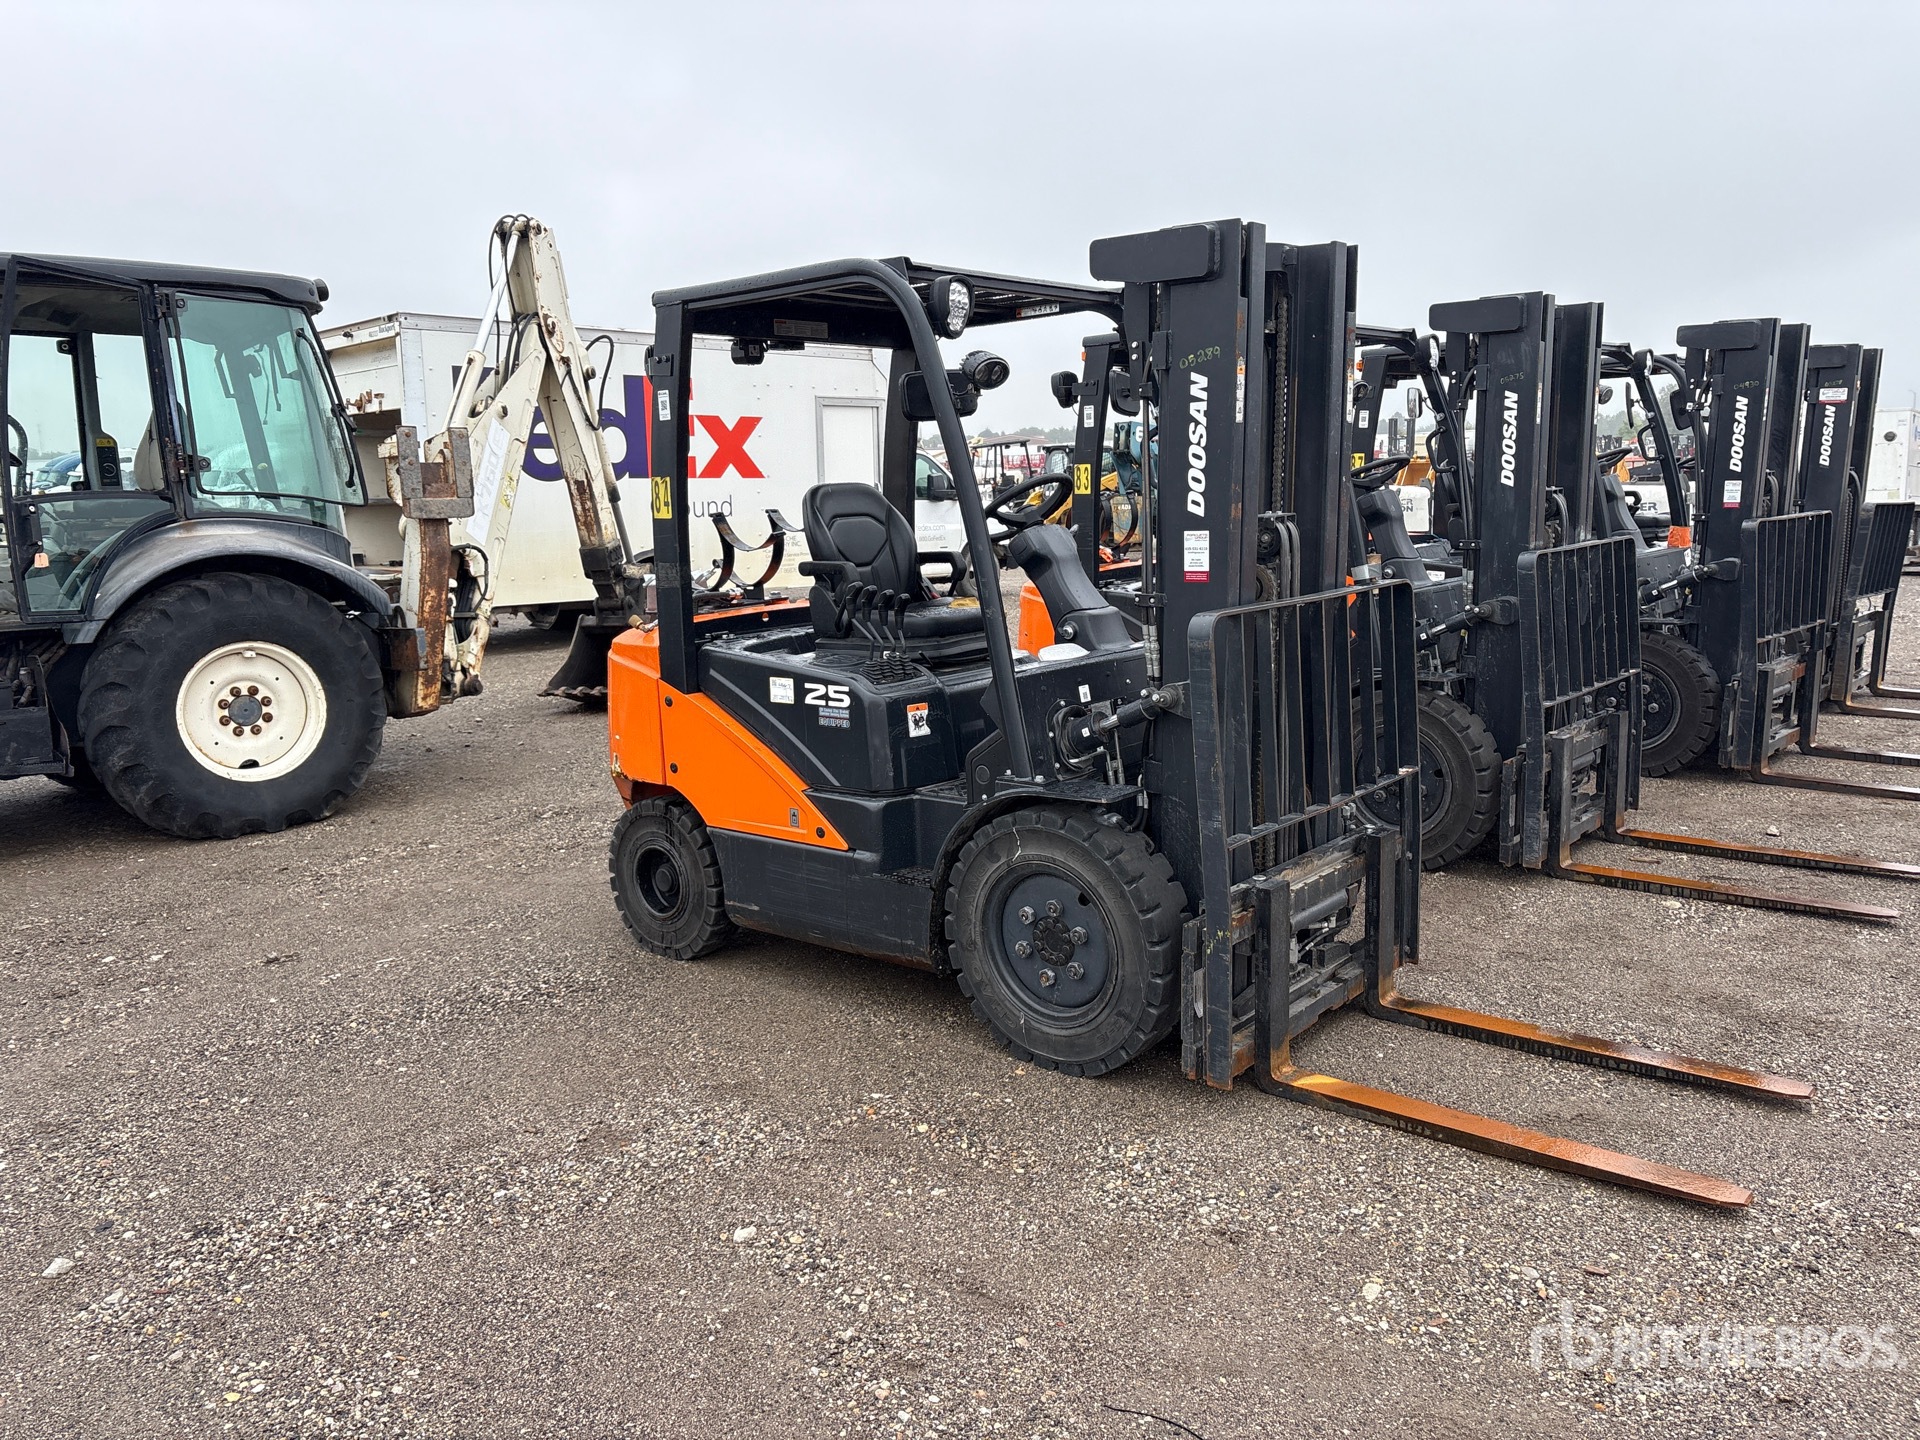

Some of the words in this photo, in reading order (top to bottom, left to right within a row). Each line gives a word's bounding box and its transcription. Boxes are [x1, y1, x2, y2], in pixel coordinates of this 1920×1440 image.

[1179, 346, 1221, 369] 05289
[452, 366, 766, 482] edx
[1187, 372, 1208, 517] DOOSAN
[1501, 391, 1518, 487] DOOSAN
[1729, 395, 1748, 472] DOOSAN
[1819, 404, 1836, 466] DOOSAN
[654, 480, 670, 514] 84
[1075, 466, 1090, 491] 83
[804, 682, 851, 708] 25
[818, 716, 851, 729] EQUIPPED
